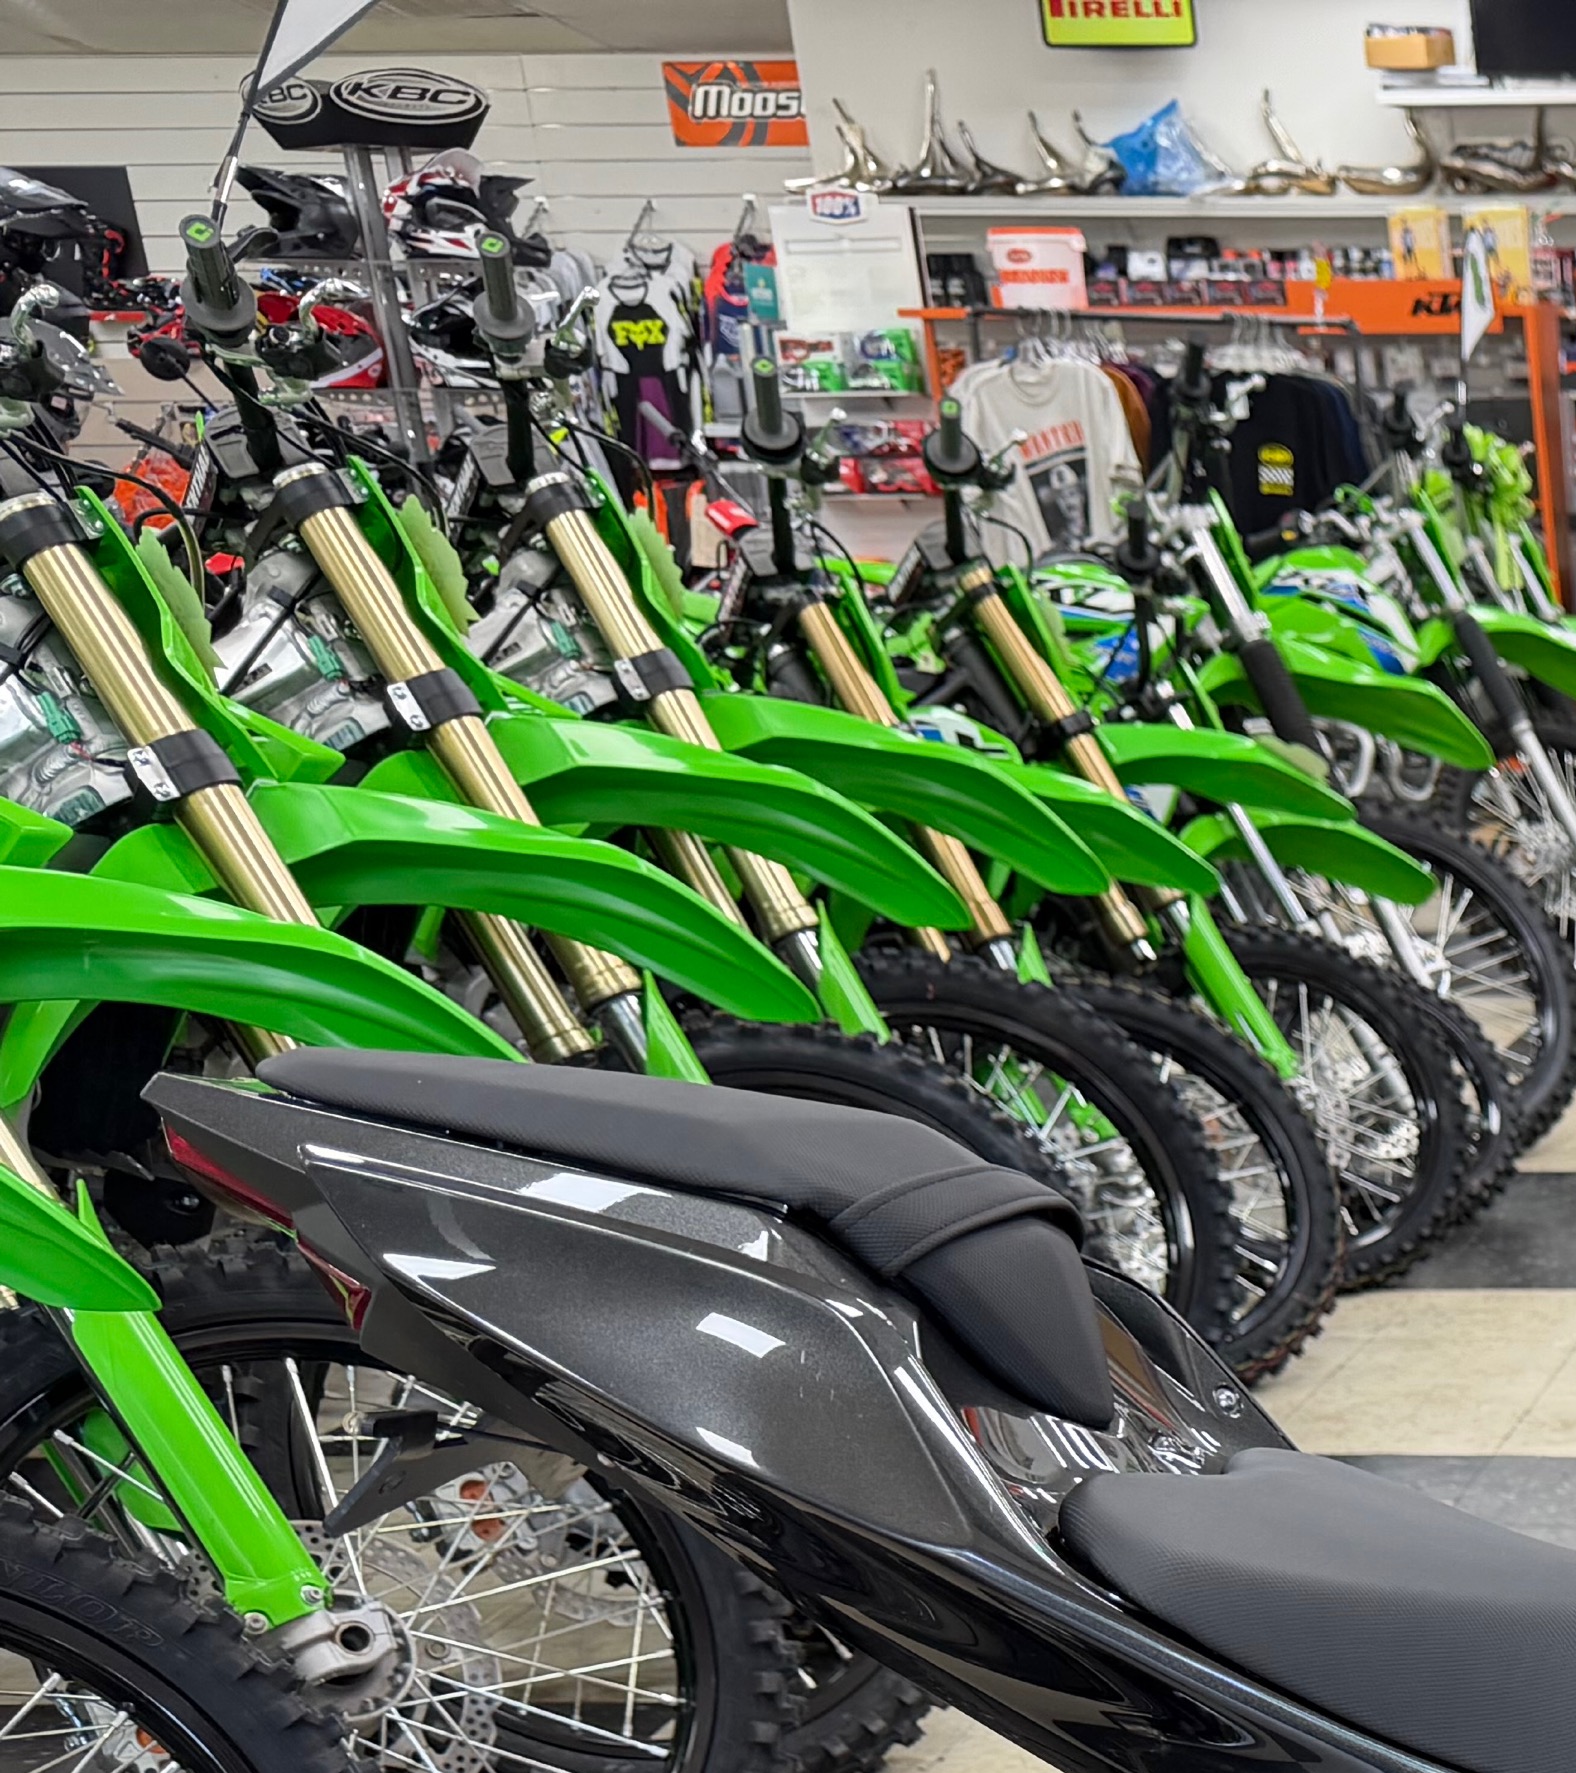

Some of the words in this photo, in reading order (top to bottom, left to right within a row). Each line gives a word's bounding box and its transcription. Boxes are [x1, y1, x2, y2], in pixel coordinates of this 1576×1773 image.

[262, 83, 308, 104] BC
[348, 80, 471, 105] KBC
[1412, 292, 1462, 317] KT
